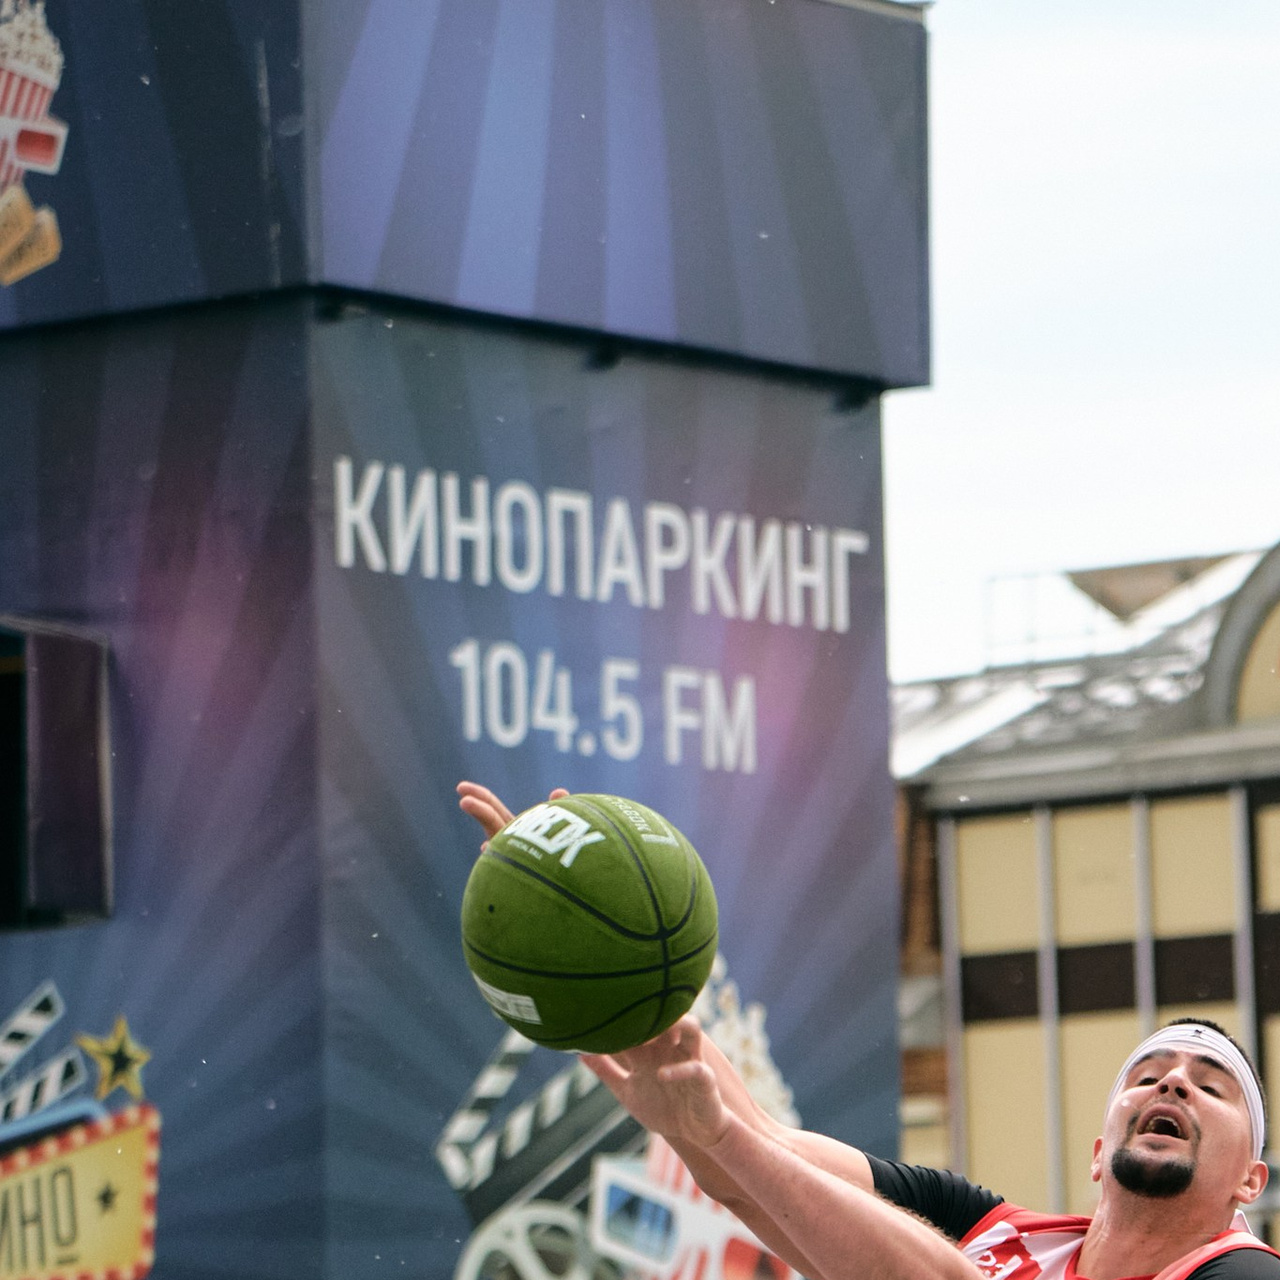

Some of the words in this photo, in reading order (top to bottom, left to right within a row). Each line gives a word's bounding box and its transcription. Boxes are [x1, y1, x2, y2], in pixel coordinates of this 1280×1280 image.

[333, 455, 869, 633] КИНОПАРКИНГ
[449, 638, 643, 761] 104.5
[664, 664, 757, 775] FM
